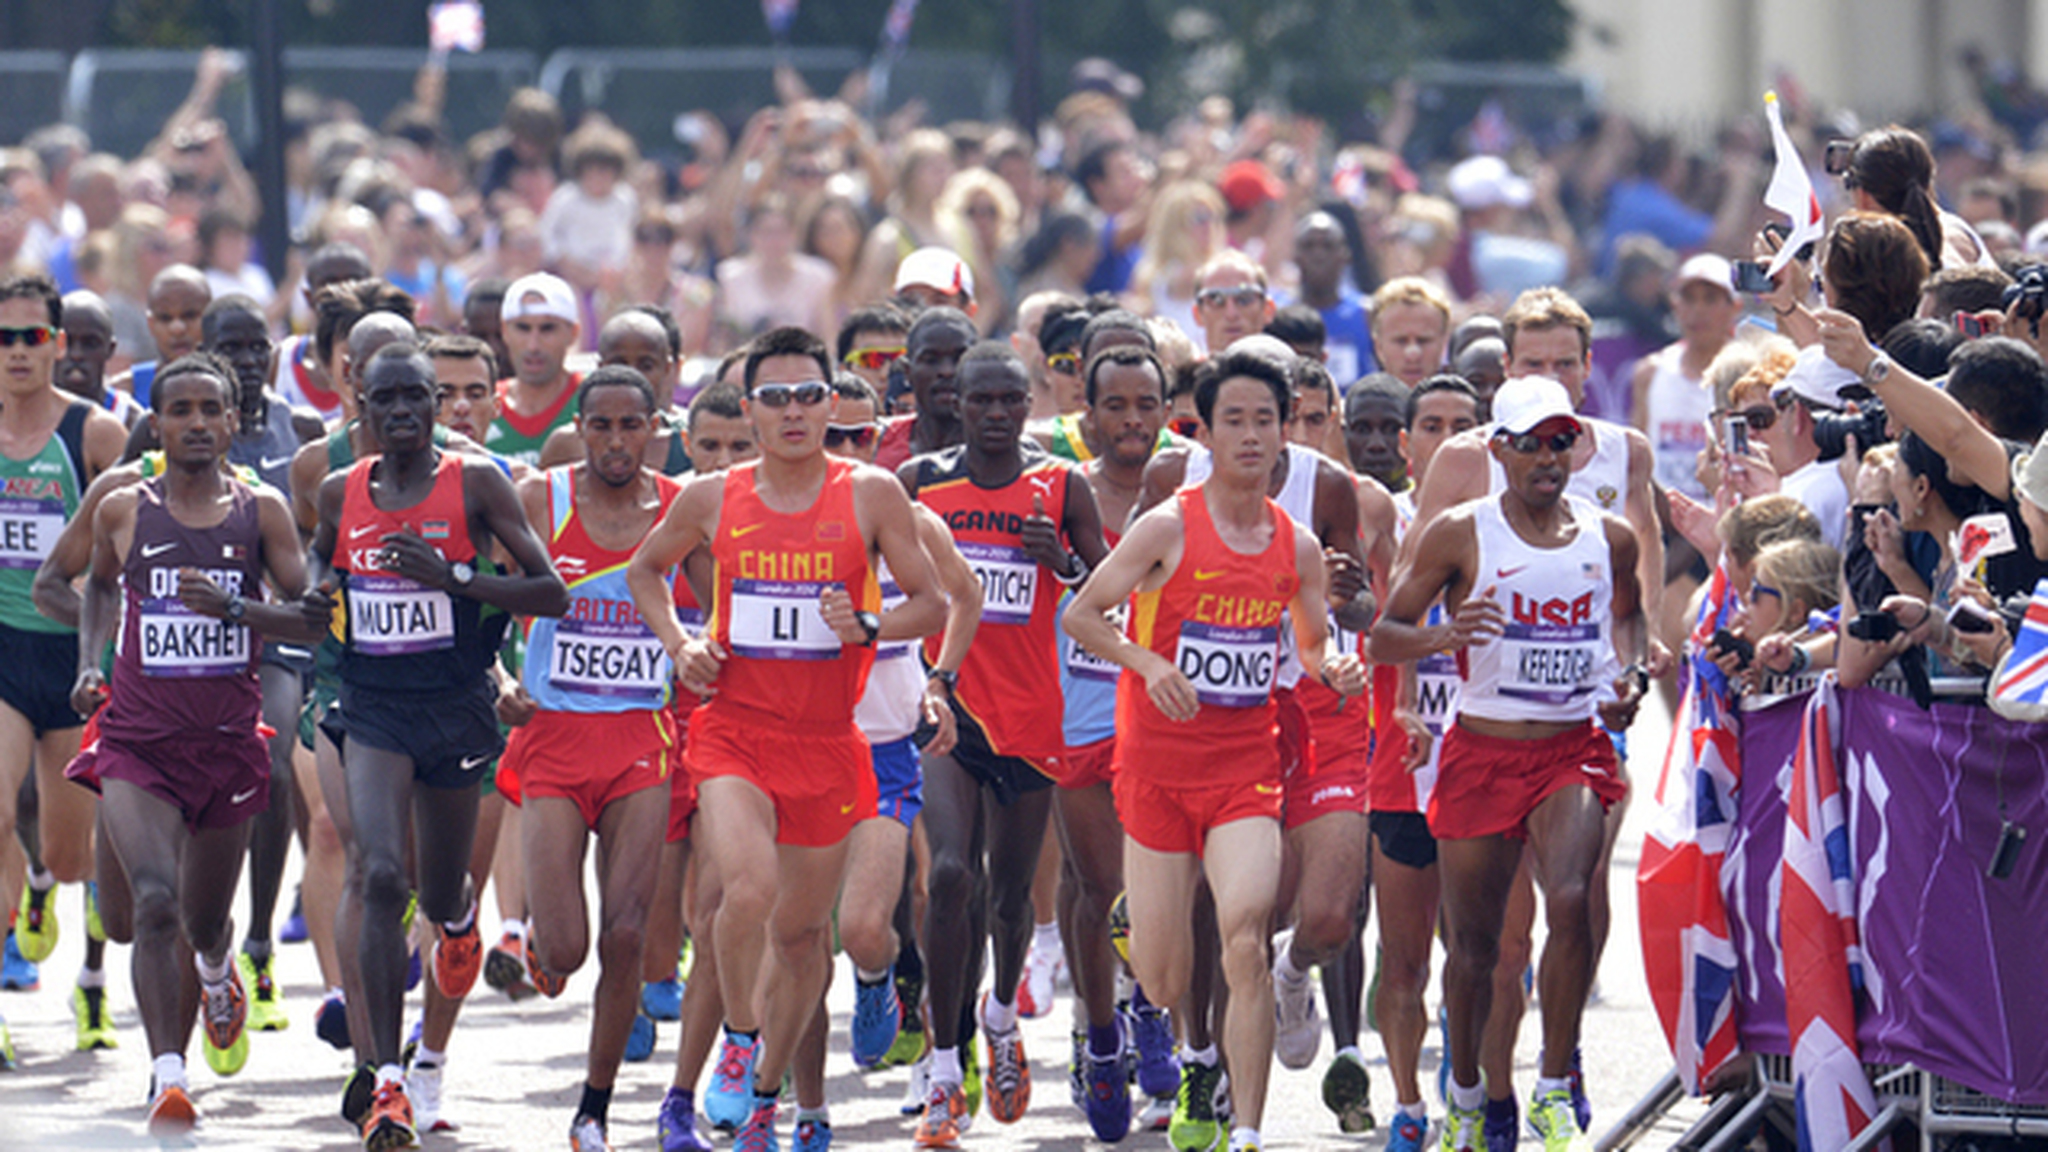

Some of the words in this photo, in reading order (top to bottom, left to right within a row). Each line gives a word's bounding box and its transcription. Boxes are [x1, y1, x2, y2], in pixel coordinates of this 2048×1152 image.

[942, 509, 1024, 535] GAND
[739, 550, 834, 580] CHINA
[357, 601, 437, 636] MUTAI
[773, 607, 798, 641] LI
[1512, 590, 1594, 627] USA
[558, 641, 664, 681] TSEGAY
[1180, 646, 1272, 687] DONG
